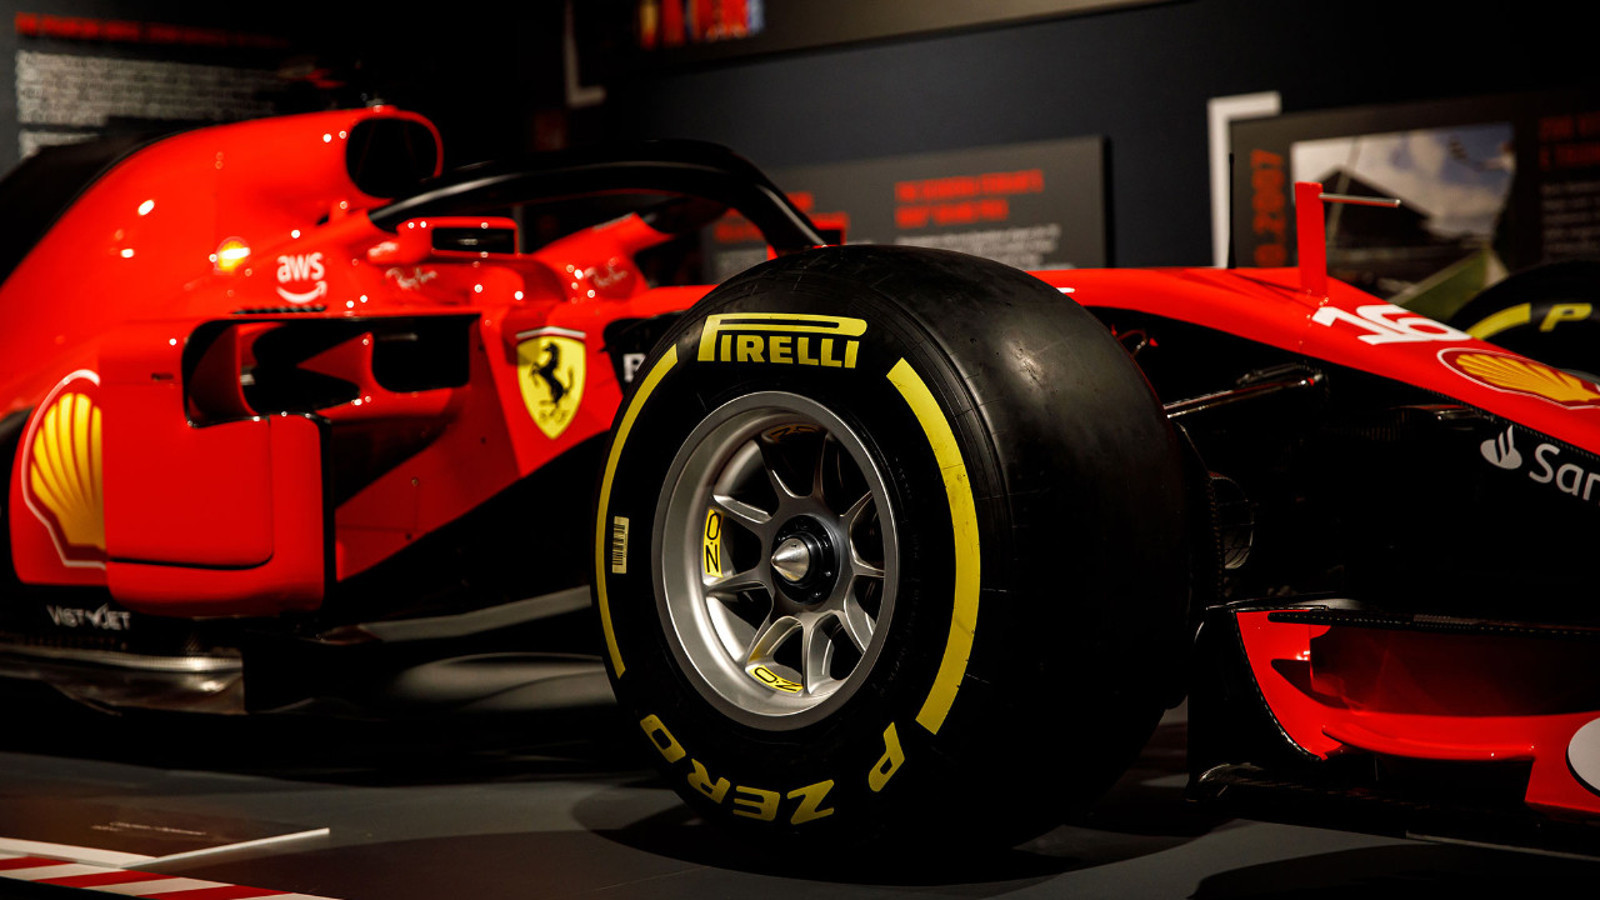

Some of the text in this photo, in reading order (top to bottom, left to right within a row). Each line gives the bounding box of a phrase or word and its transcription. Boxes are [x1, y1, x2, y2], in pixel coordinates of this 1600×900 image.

[277, 252, 325, 283] aws
[697, 312, 868, 370] PIRELLI
[1312, 304, 1472, 345] 16
[639, 713, 906, 827] P ZERO
